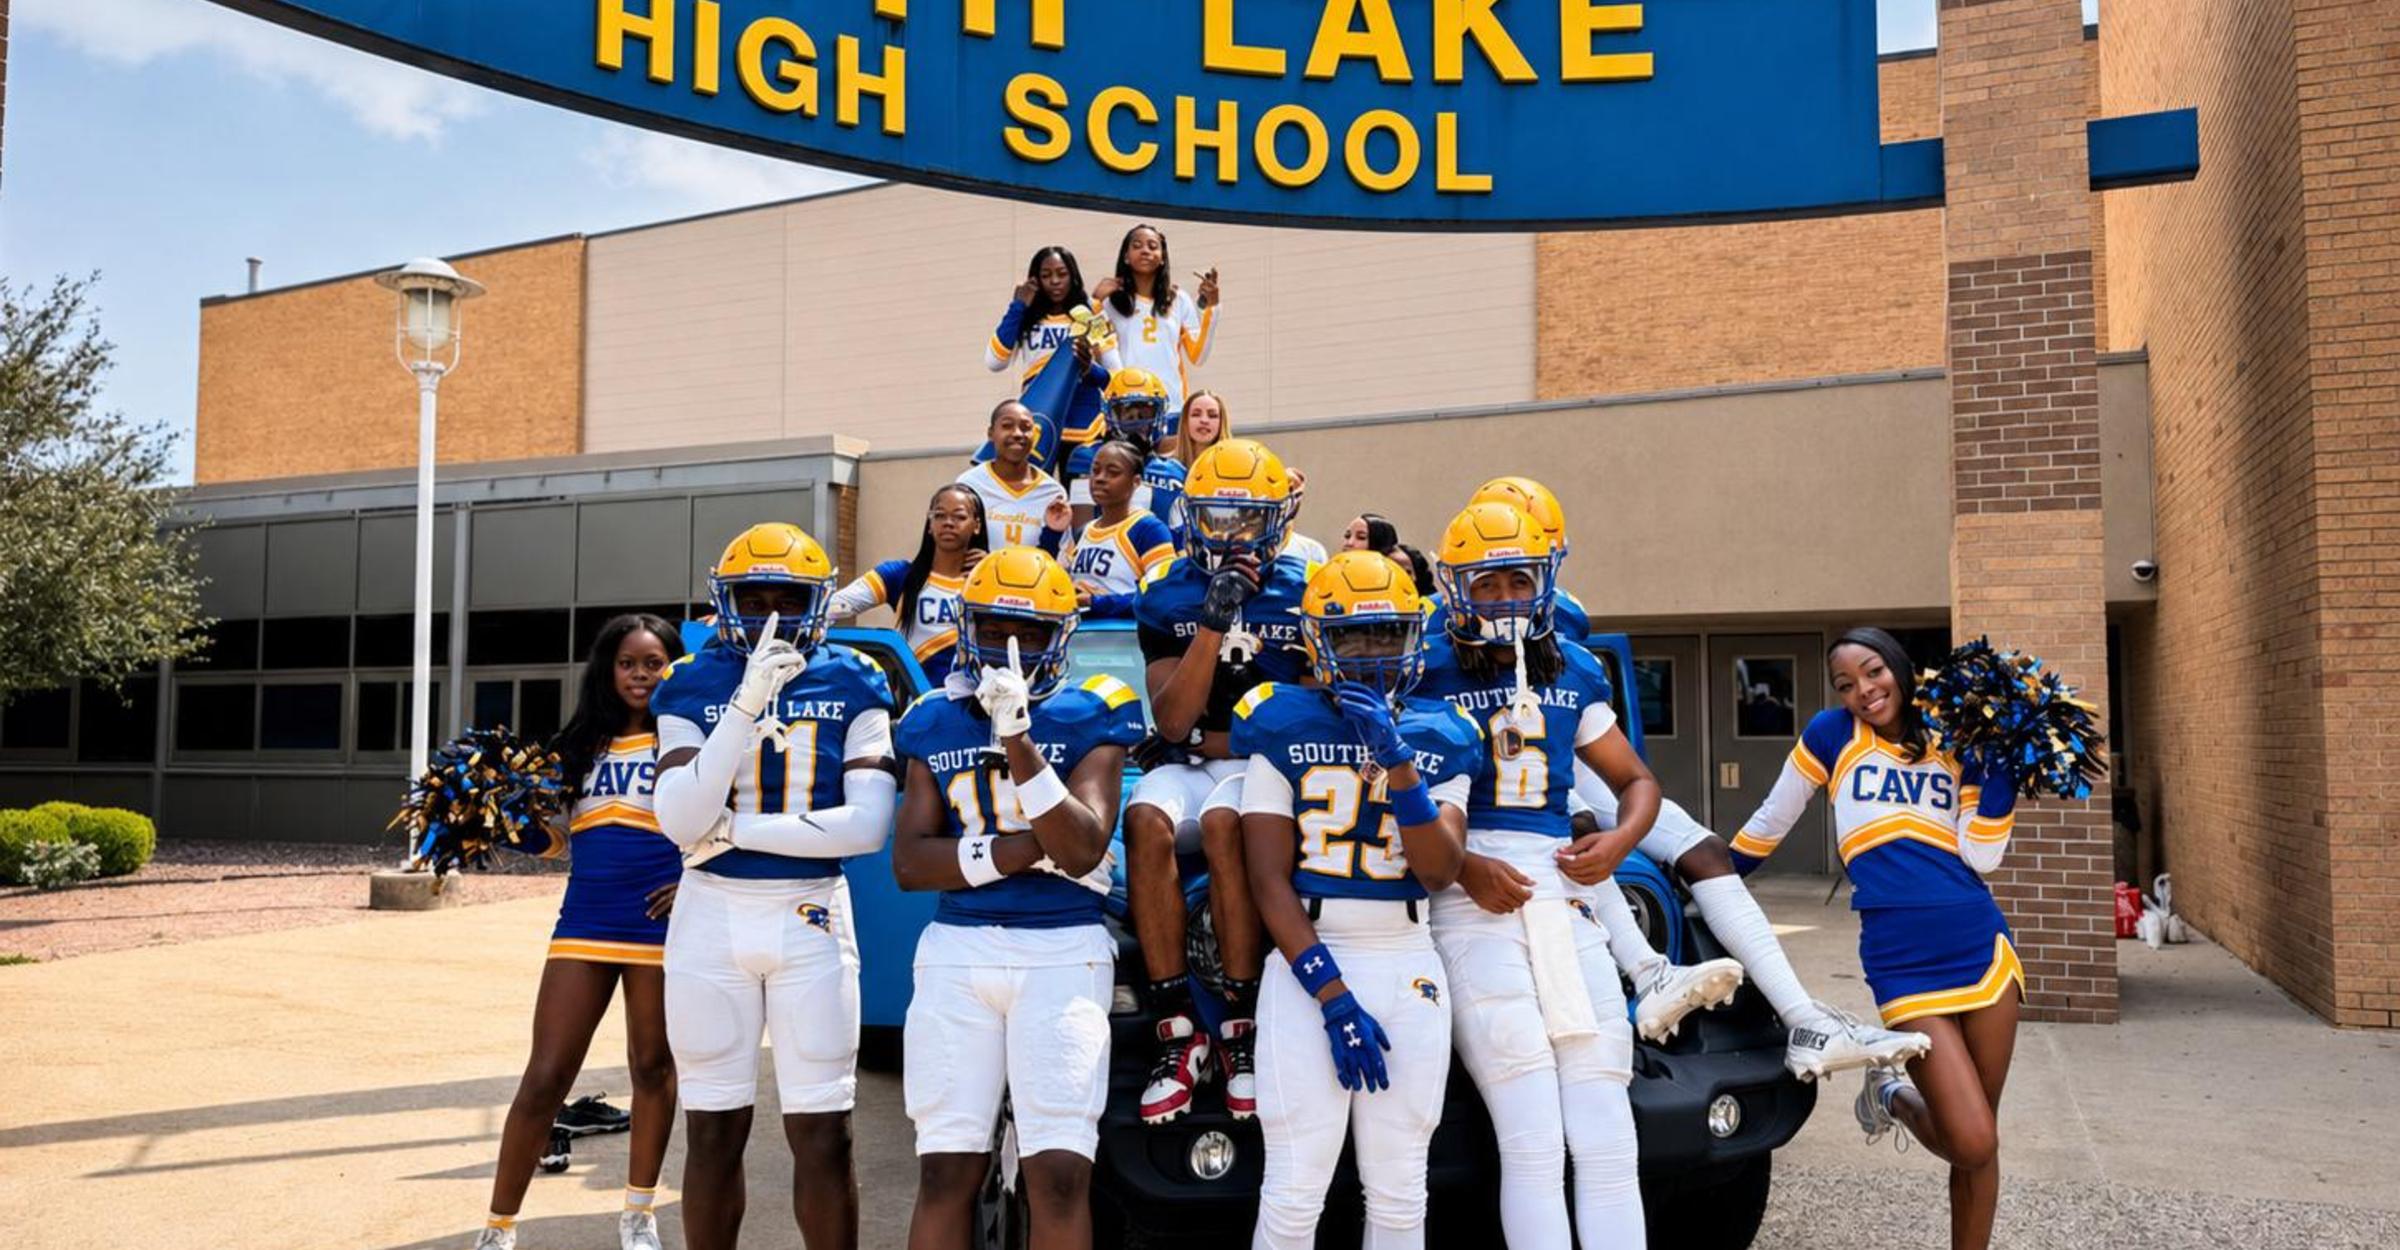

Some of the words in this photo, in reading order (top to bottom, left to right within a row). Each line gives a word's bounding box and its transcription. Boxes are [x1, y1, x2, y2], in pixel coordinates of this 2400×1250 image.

[1203, 0, 1654, 83] LAKE
[596, 0, 906, 136] HIGH
[1003, 72, 1493, 192] SCHOOL
[1027, 323, 1068, 351] CAV
[1142, 316, 1159, 343] 2
[1004, 522, 1022, 546] 4
[1068, 547, 1116, 577] AVS
[786, 700, 846, 721] LAKE
[927, 747, 986, 773] SOUT
[1412, 750, 1444, 775] KE
[1488, 706, 1549, 809] 6
[583, 761, 656, 797] AVS
[1852, 764, 1953, 811] CAVS
[1297, 765, 1409, 881] 23
